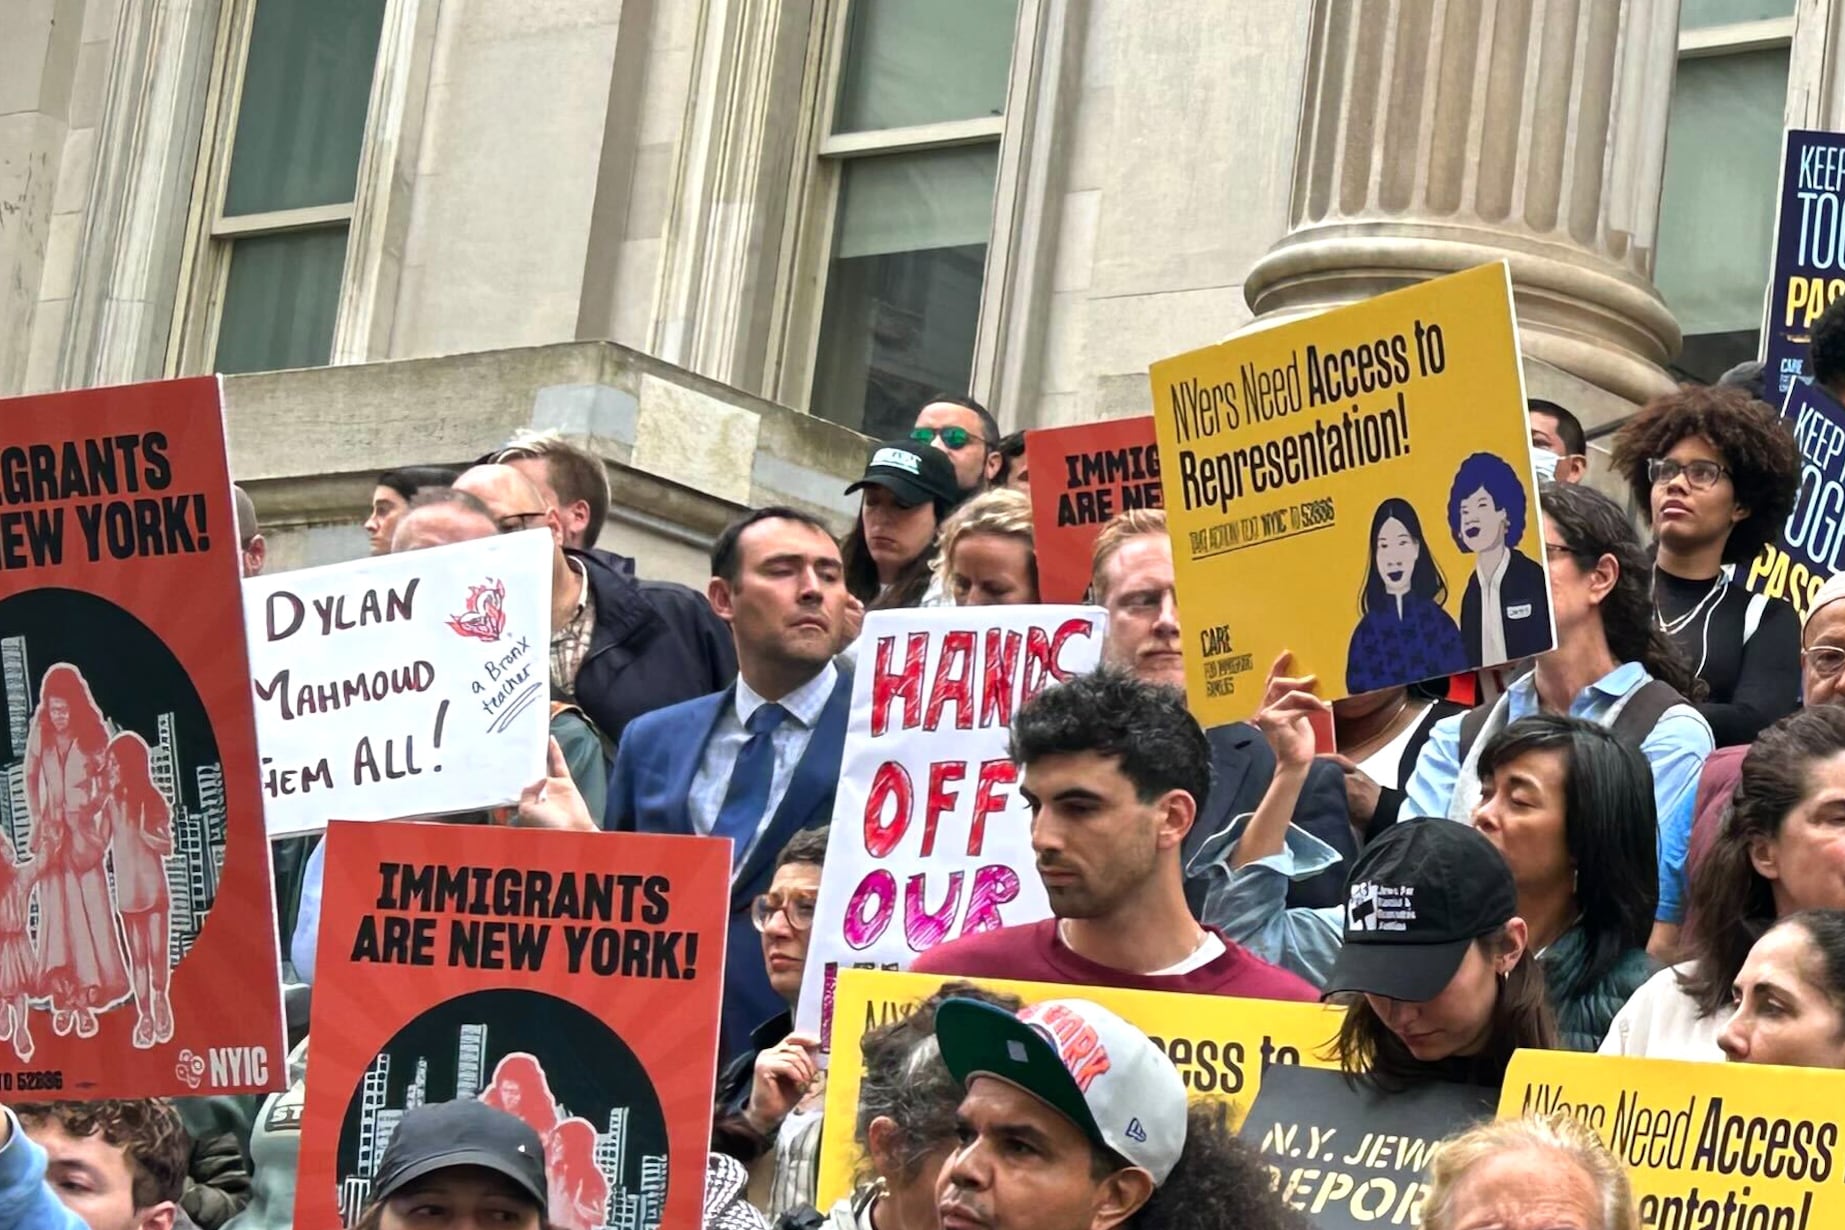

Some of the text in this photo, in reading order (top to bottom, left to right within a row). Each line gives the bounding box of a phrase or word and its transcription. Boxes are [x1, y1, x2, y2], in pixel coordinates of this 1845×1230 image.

[1170, 320, 1446, 445] NYers Need Access to
[0, 431, 172, 506] GRANTS
[1179, 392, 1412, 515] Representation!
[1794, 402, 1845, 470] KEEP
[0, 493, 211, 570] EW YORK!
[1057, 489, 1115, 528] ARE
[266, 577, 421, 642] DYLAN
[1200, 624, 1232, 658] CARE
[254, 660, 436, 721] MAHMOUD
[471, 636, 532, 695] a Bronx
[482, 662, 532, 716] teacher
[353, 699, 451, 786] ALL!
[864, 758, 1023, 859] OFF
[376, 862, 671, 925] IMMIGRANTS
[843, 865, 1022, 953] OUR
[350, 914, 701, 981] ARE NEW YORK!
[210, 1048, 269, 1087] NYIC
[1147, 1035, 1245, 1094] ess
[1261, 1122, 1337, 1163] N.Y.
[1610, 1089, 1696, 1171] Need
[1691, 1097, 1835, 1184] Access
